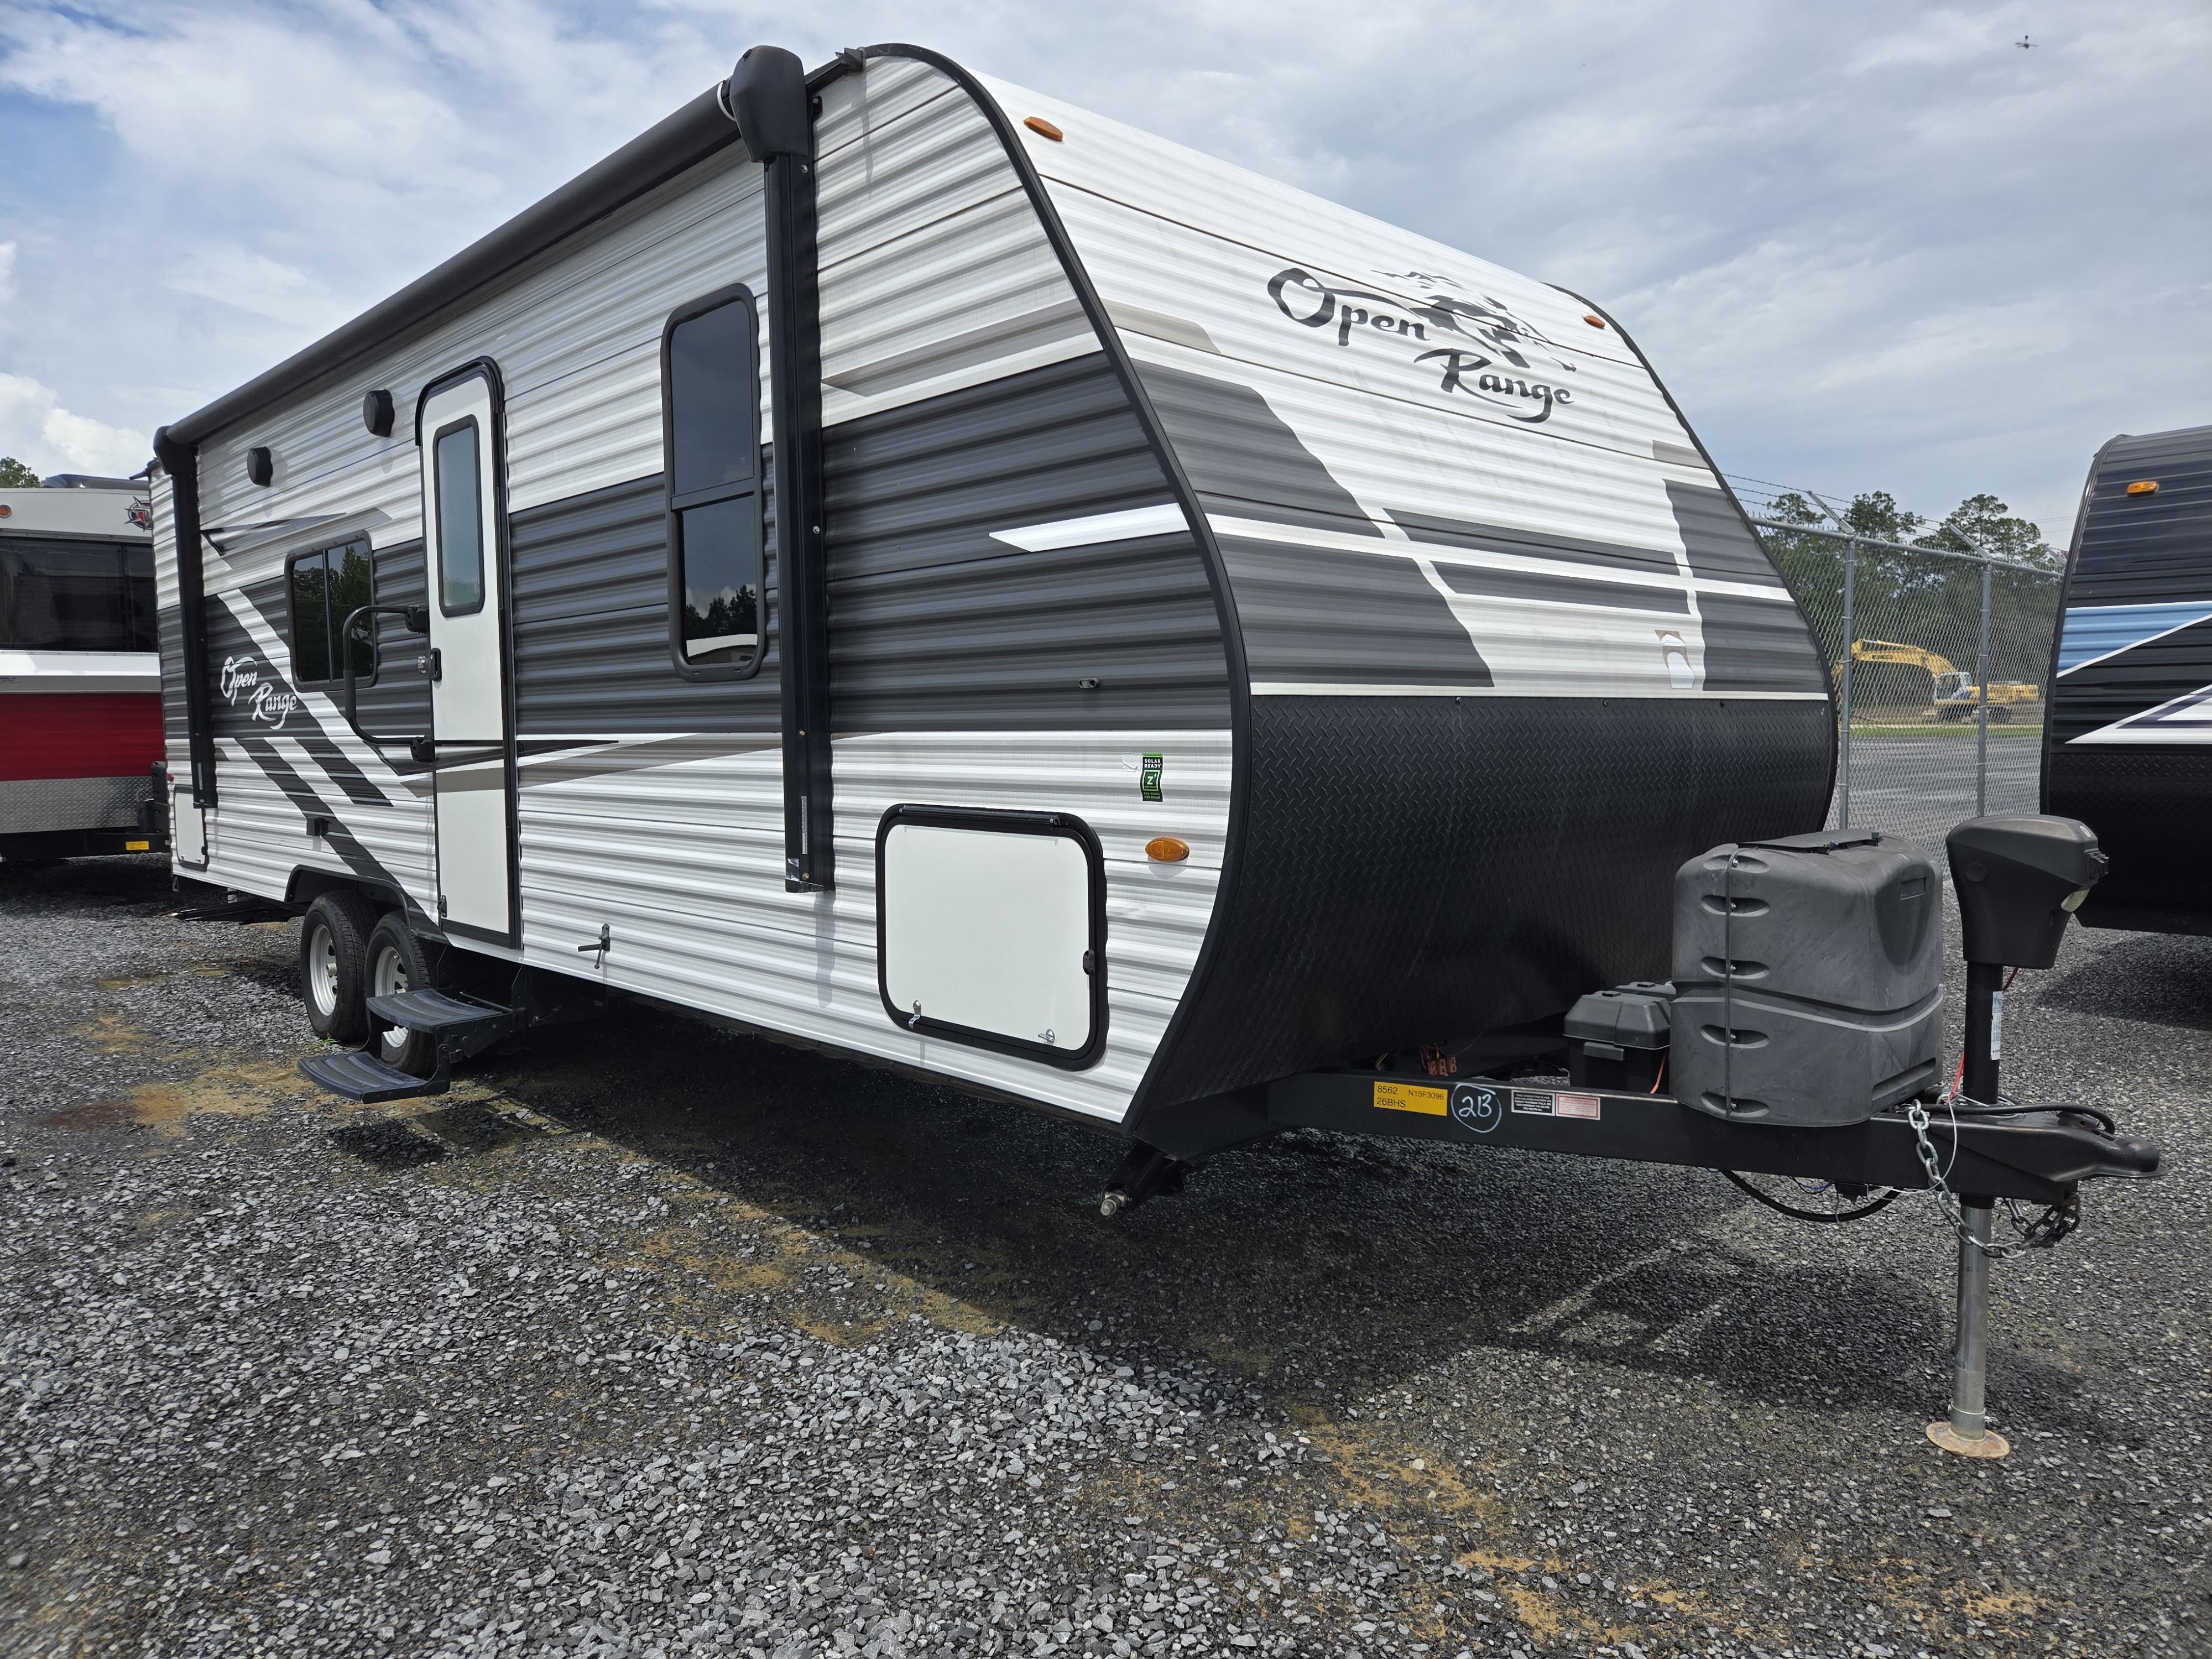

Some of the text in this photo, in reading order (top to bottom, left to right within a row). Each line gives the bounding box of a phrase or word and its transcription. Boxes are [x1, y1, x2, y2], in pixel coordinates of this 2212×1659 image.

[1267, 268, 1431, 346] Open
[1413, 348, 1575, 424] Range
[221, 656, 257, 706] Open
[248, 682, 298, 730] Range
[1147, 776, 1154, 785] Z
[1377, 1085, 1444, 1100] 8562 N15F3096
[1377, 1097, 1406, 1108] 26BHS
